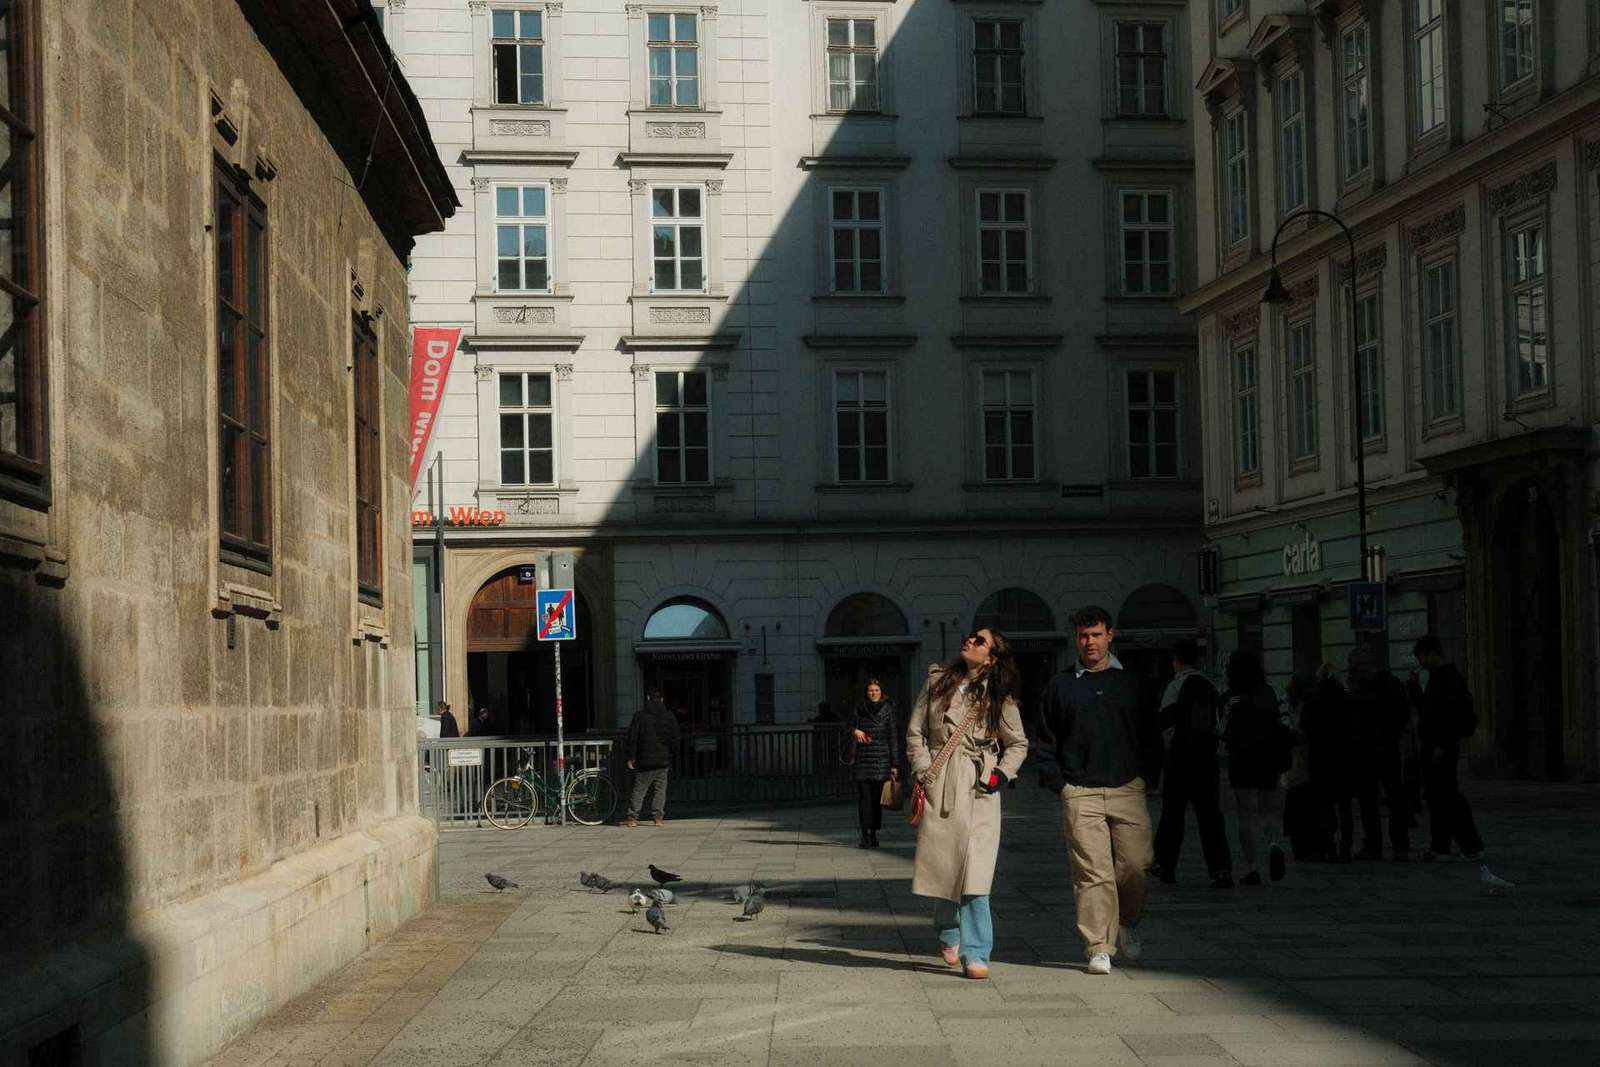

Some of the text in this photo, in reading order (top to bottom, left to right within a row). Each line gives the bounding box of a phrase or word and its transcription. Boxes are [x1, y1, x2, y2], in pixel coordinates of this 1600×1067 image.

[421, 340, 449, 401] Dom
[449, 504, 506, 527] Wien
[1283, 530, 1320, 576] carla
